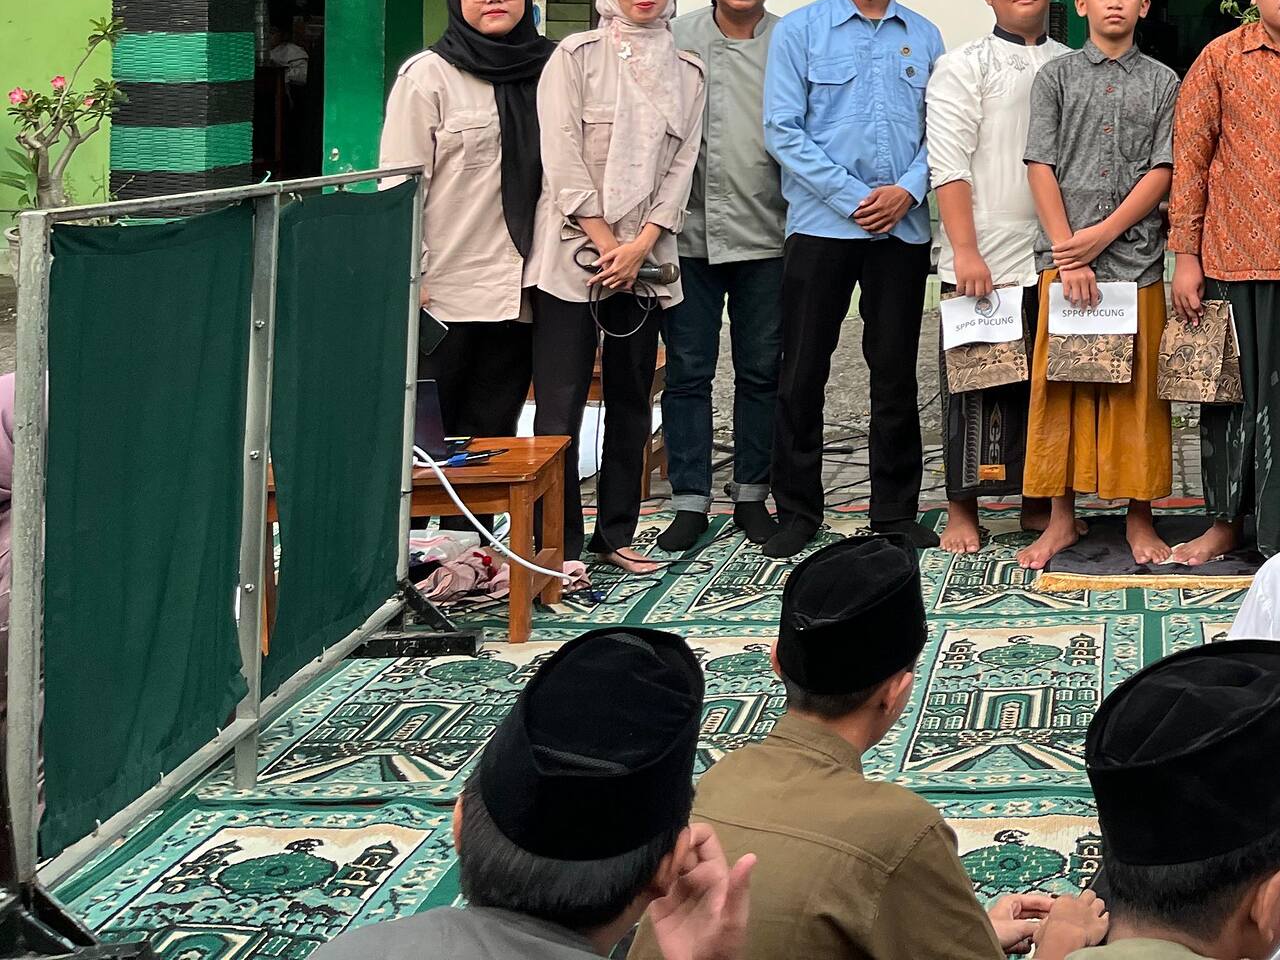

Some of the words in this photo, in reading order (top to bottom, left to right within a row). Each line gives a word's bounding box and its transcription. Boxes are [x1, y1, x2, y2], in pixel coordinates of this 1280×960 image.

[1062, 309, 1085, 318] SPPG
[1087, 308, 1125, 317] PUCUNG
[955, 319, 976, 332] SPPG
[978, 316, 1014, 326] PUCUNG
